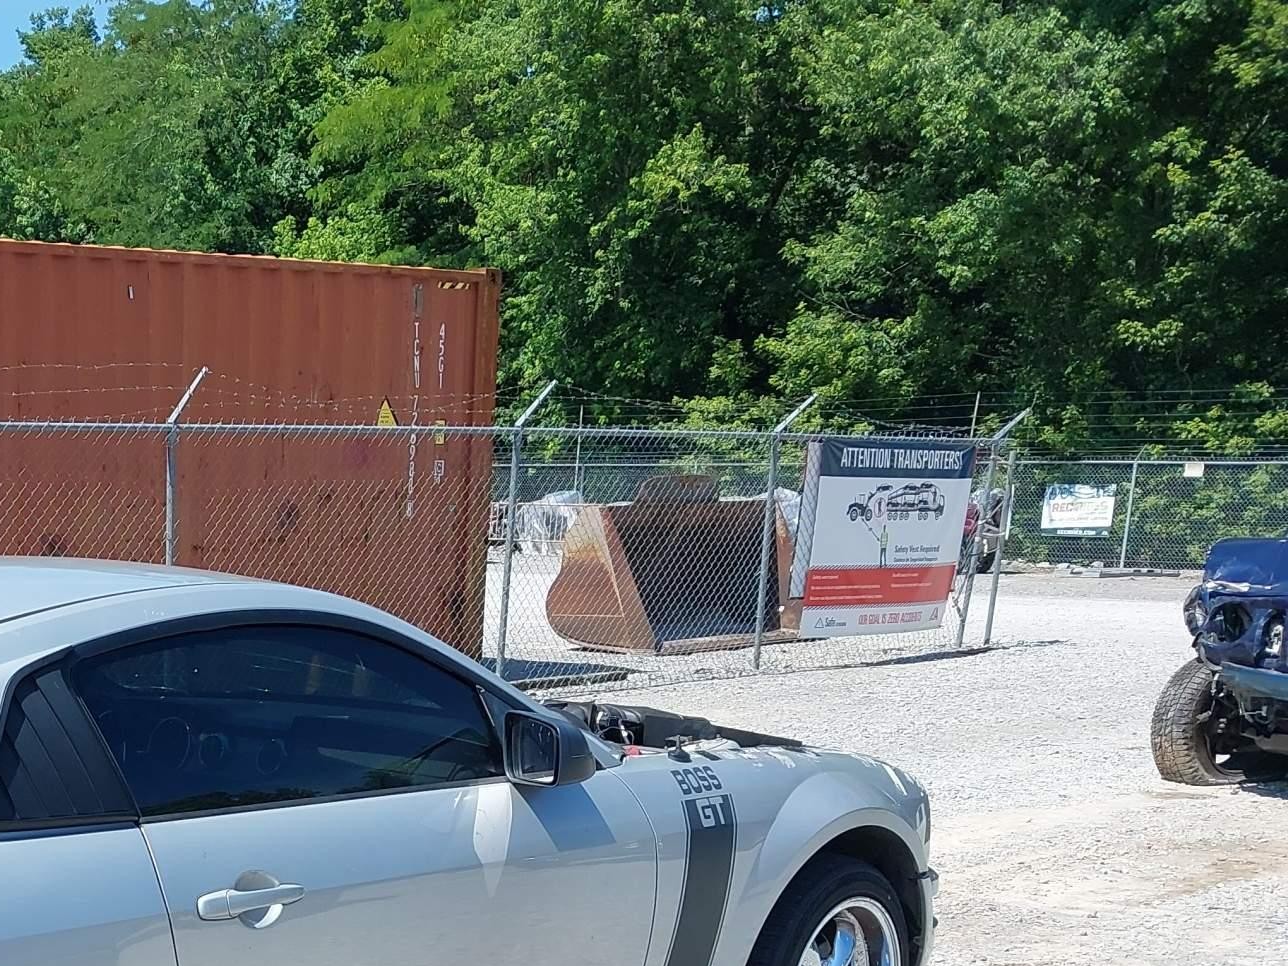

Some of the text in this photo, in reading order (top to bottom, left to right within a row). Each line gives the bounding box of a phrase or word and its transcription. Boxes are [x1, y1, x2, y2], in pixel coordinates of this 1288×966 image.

[438, 323, 446, 389] 45G1
[840, 447, 963, 470] ATTENTION TRANSPORTERS!
[670, 765, 722, 795] BOSS
[695, 796, 725, 828] GT
